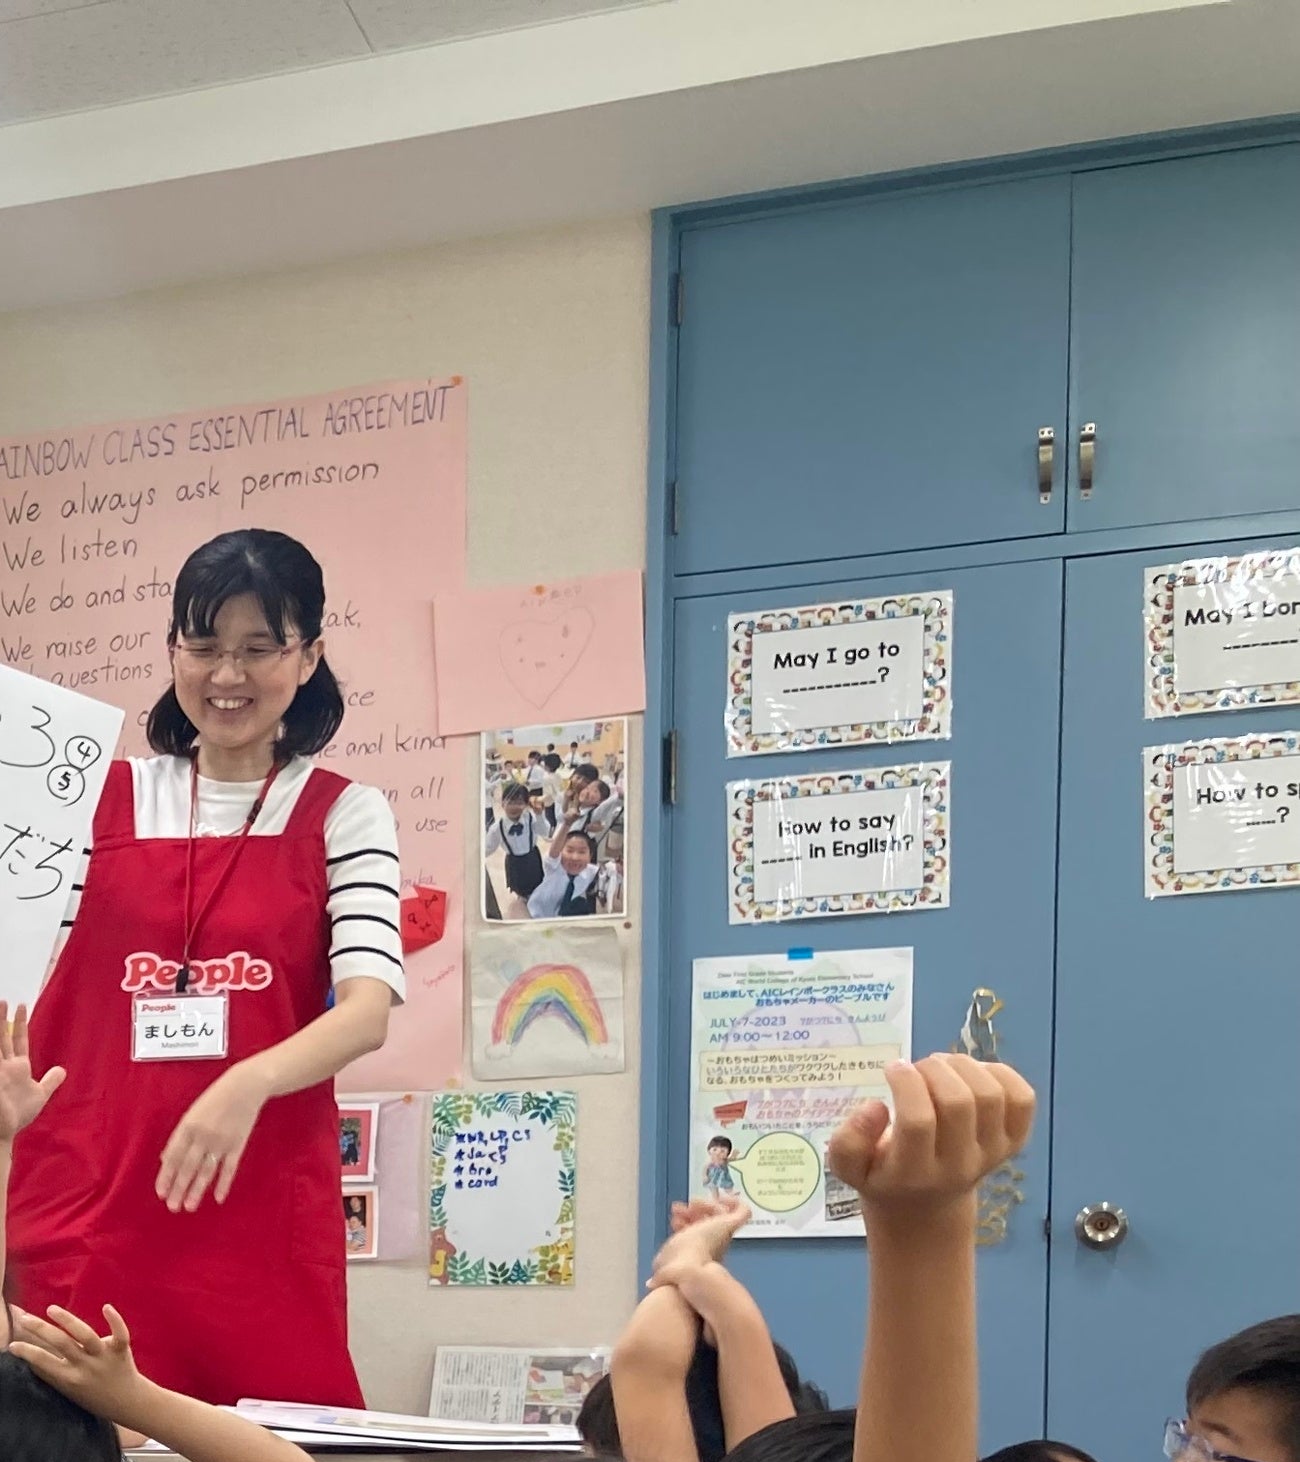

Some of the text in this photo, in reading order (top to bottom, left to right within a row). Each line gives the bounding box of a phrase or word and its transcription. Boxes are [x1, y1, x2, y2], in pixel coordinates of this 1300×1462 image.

[103, 422, 176, 465] CLASS
[189, 406, 309, 452] ESSENTIAL
[323, 386, 454, 436] AGREEMENT
[2, 461, 380, 525] We always ask permission
[2, 530, 138, 571] We listen
[1, 567, 173, 617] We do and sta
[1185, 604, 1233, 626] May
[1, 632, 150, 662] We raise our
[774, 642, 900, 669] May I go to
[346, 734, 383, 757] and
[411, 777, 444, 799] all
[1197, 786, 1246, 804] How
[1256, 782, 1279, 799] to
[416, 818, 448, 832] use
[830, 817, 851, 832] to
[859, 814, 896, 830] say
[809, 842, 826, 859] in
[123, 953, 271, 992] People
[142, 1004, 176, 1013] People
[145, 1022, 214, 1039] ましもん
[710, 1032, 729, 1043] AM
